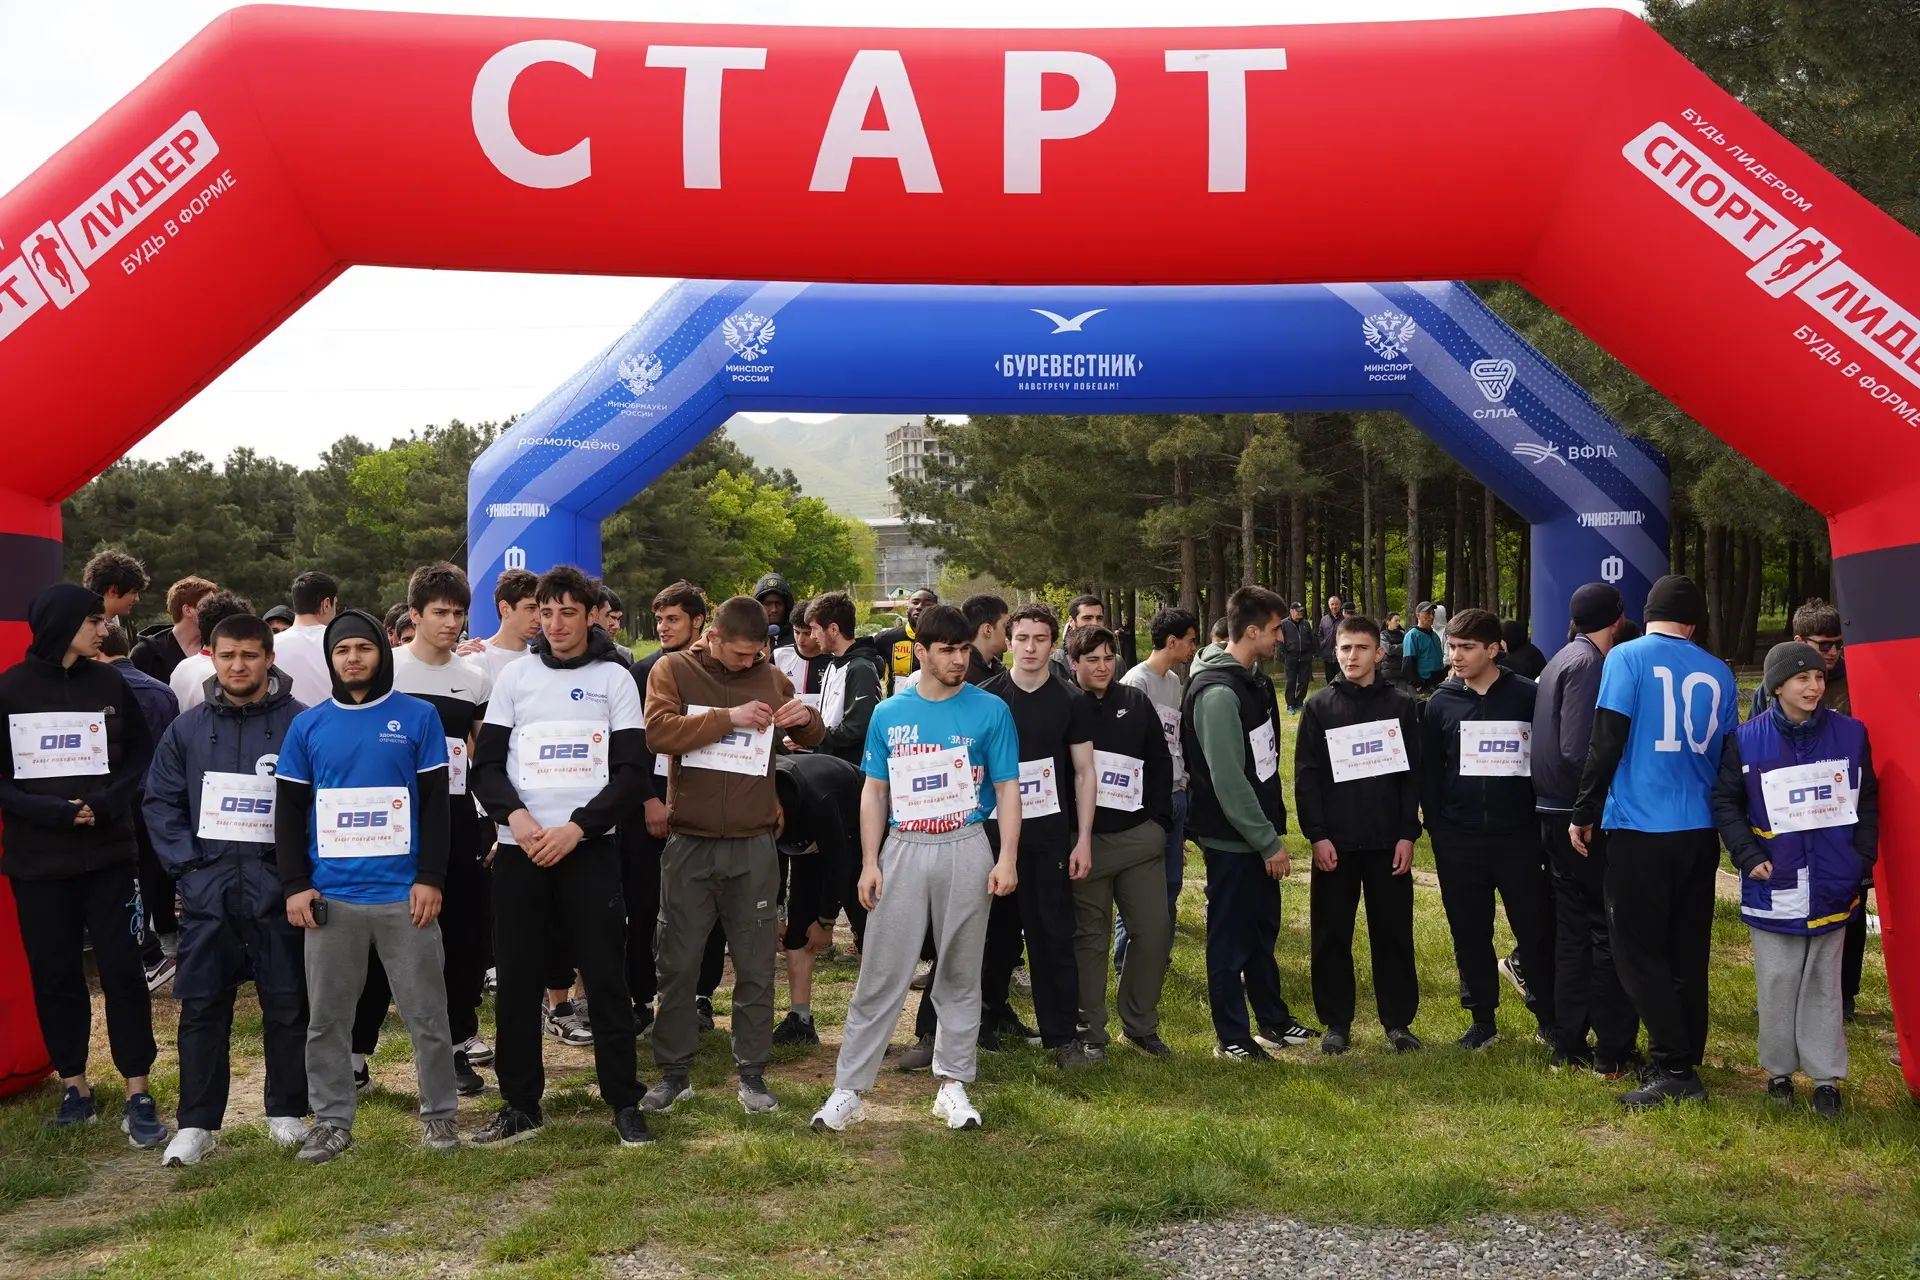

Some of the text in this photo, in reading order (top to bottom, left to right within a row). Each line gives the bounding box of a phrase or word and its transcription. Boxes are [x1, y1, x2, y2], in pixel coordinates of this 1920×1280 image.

[471, 39, 1287, 193] СТАРТ
[1681, 108, 1813, 212] БУДЬ ЛИДЕРОМ
[80, 129, 199, 250] ЛИДЕР
[1643, 135, 1778, 243] СПОРТ
[120, 169, 237, 275] БУДЬ В ФОРМЕ
[0, 275, 28, 314] Т
[725, 365, 774, 374] МИНСПОРТ
[1003, 354, 1137, 377] БУРЕВЕСТНИК
[1363, 363, 1413, 372] МИНСПОРТ
[732, 374, 770, 382] РОССИИ
[1368, 374, 1407, 382] РОССИИ
[1792, 324, 1920, 428] БУДЬ В ФОРМЕ
[1018, 382, 1120, 391] НАВСТРЕЧУ ПОБЕДАМ!
[607, 400, 668, 411] МИНОБРНАУКИ
[1472, 408, 1518, 419] СЛЛА
[620, 410, 654, 418] РОССИИ
[517, 437, 620, 451] росмолодёжь
[1568, 445, 1618, 460] ВФЛА
[489, 503, 546, 517] УНИВЕРЛИГА
[1581, 511, 1643, 527] УНИВЕРЛИГА
[1653, 666, 1721, 755] 10
[40, 734, 81, 750] 018
[717, 731, 752, 747] 27
[888, 725, 919, 747] 2024
[539, 744, 589, 760] 022
[1352, 740, 1383, 756] 012
[1479, 741, 1520, 753] 009
[912, 772, 948, 792] 031
[1789, 785, 1832, 804] 072
[220, 797, 273, 814] 035
[337, 811, 388, 828] 036
